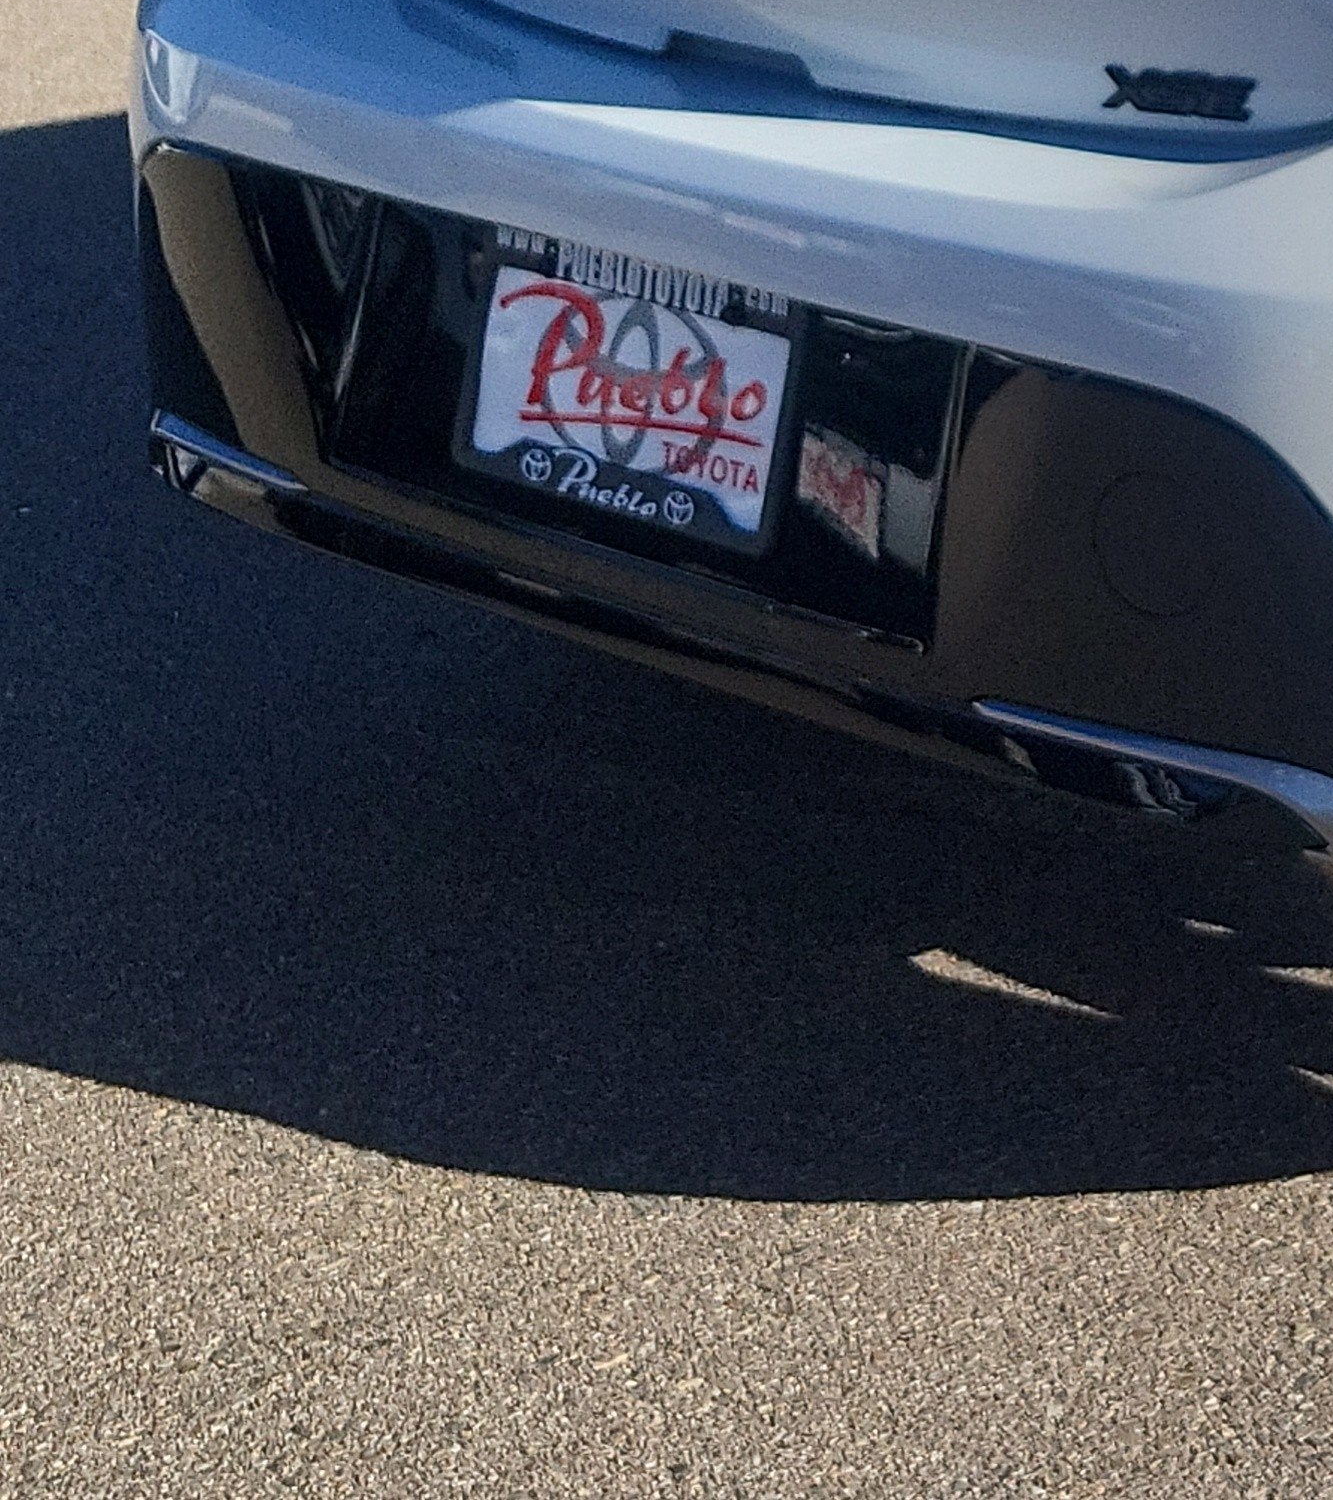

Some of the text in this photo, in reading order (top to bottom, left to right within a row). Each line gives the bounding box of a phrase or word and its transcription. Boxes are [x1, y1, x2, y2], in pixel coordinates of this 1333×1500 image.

[499, 280, 768, 422] Pueblo
[551, 447, 658, 517] Pueblo
[662, 440, 761, 494] TOYOTA
